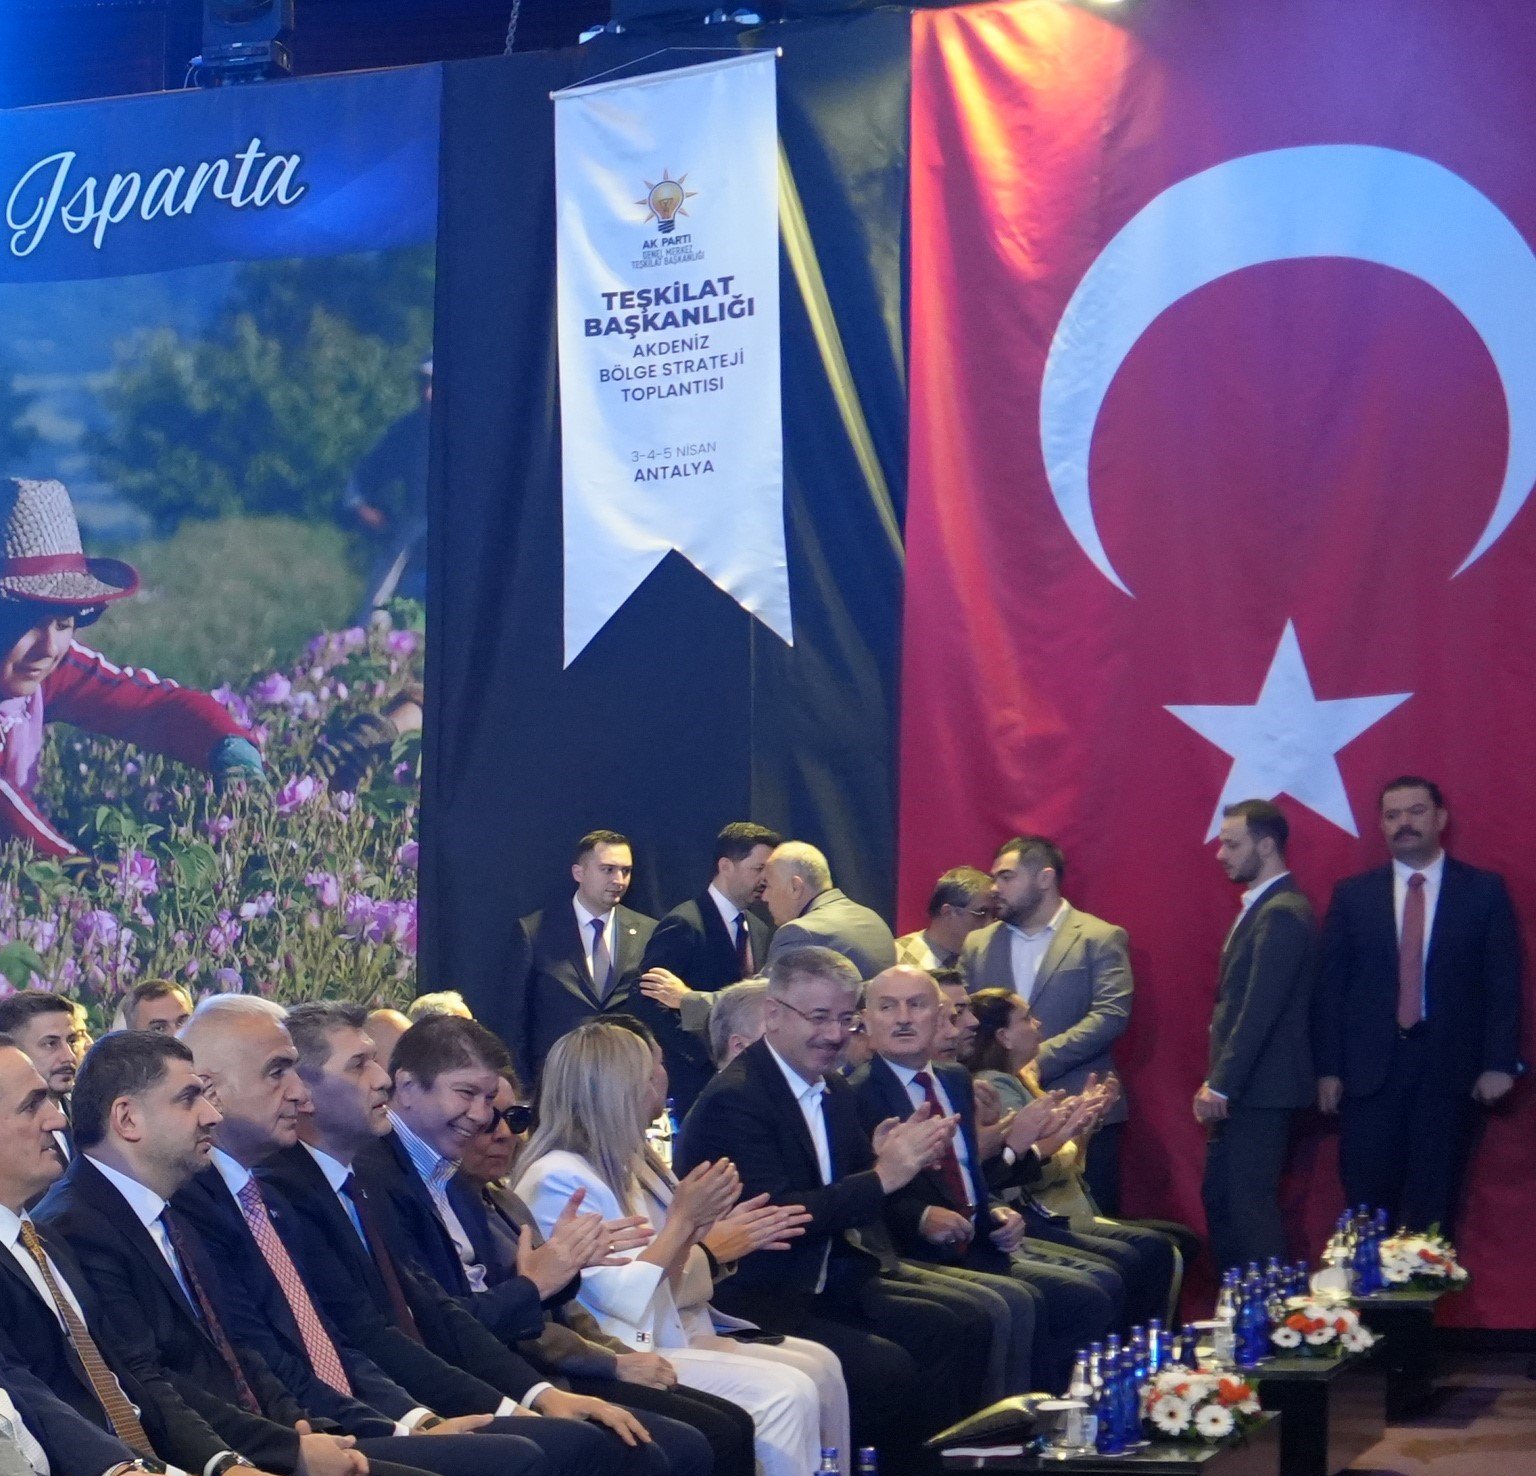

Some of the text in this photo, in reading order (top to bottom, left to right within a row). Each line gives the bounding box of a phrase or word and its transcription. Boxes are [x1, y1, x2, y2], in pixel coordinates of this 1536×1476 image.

[5, 137, 306, 257] Isparta
[642, 239, 658, 249] AK
[601, 275, 735, 314] TEŞKİLAT
[584, 293, 755, 339] BAŞKANLIĞI
[633, 333, 710, 358] AKDENİZ
[599, 348, 744, 382] BÖLGE STRATEJİ
[621, 376, 724, 402] TOPLANTISI
[631, 441, 717, 462] 3-4-5 NİSAN
[634, 460, 715, 482] ANTALYA
